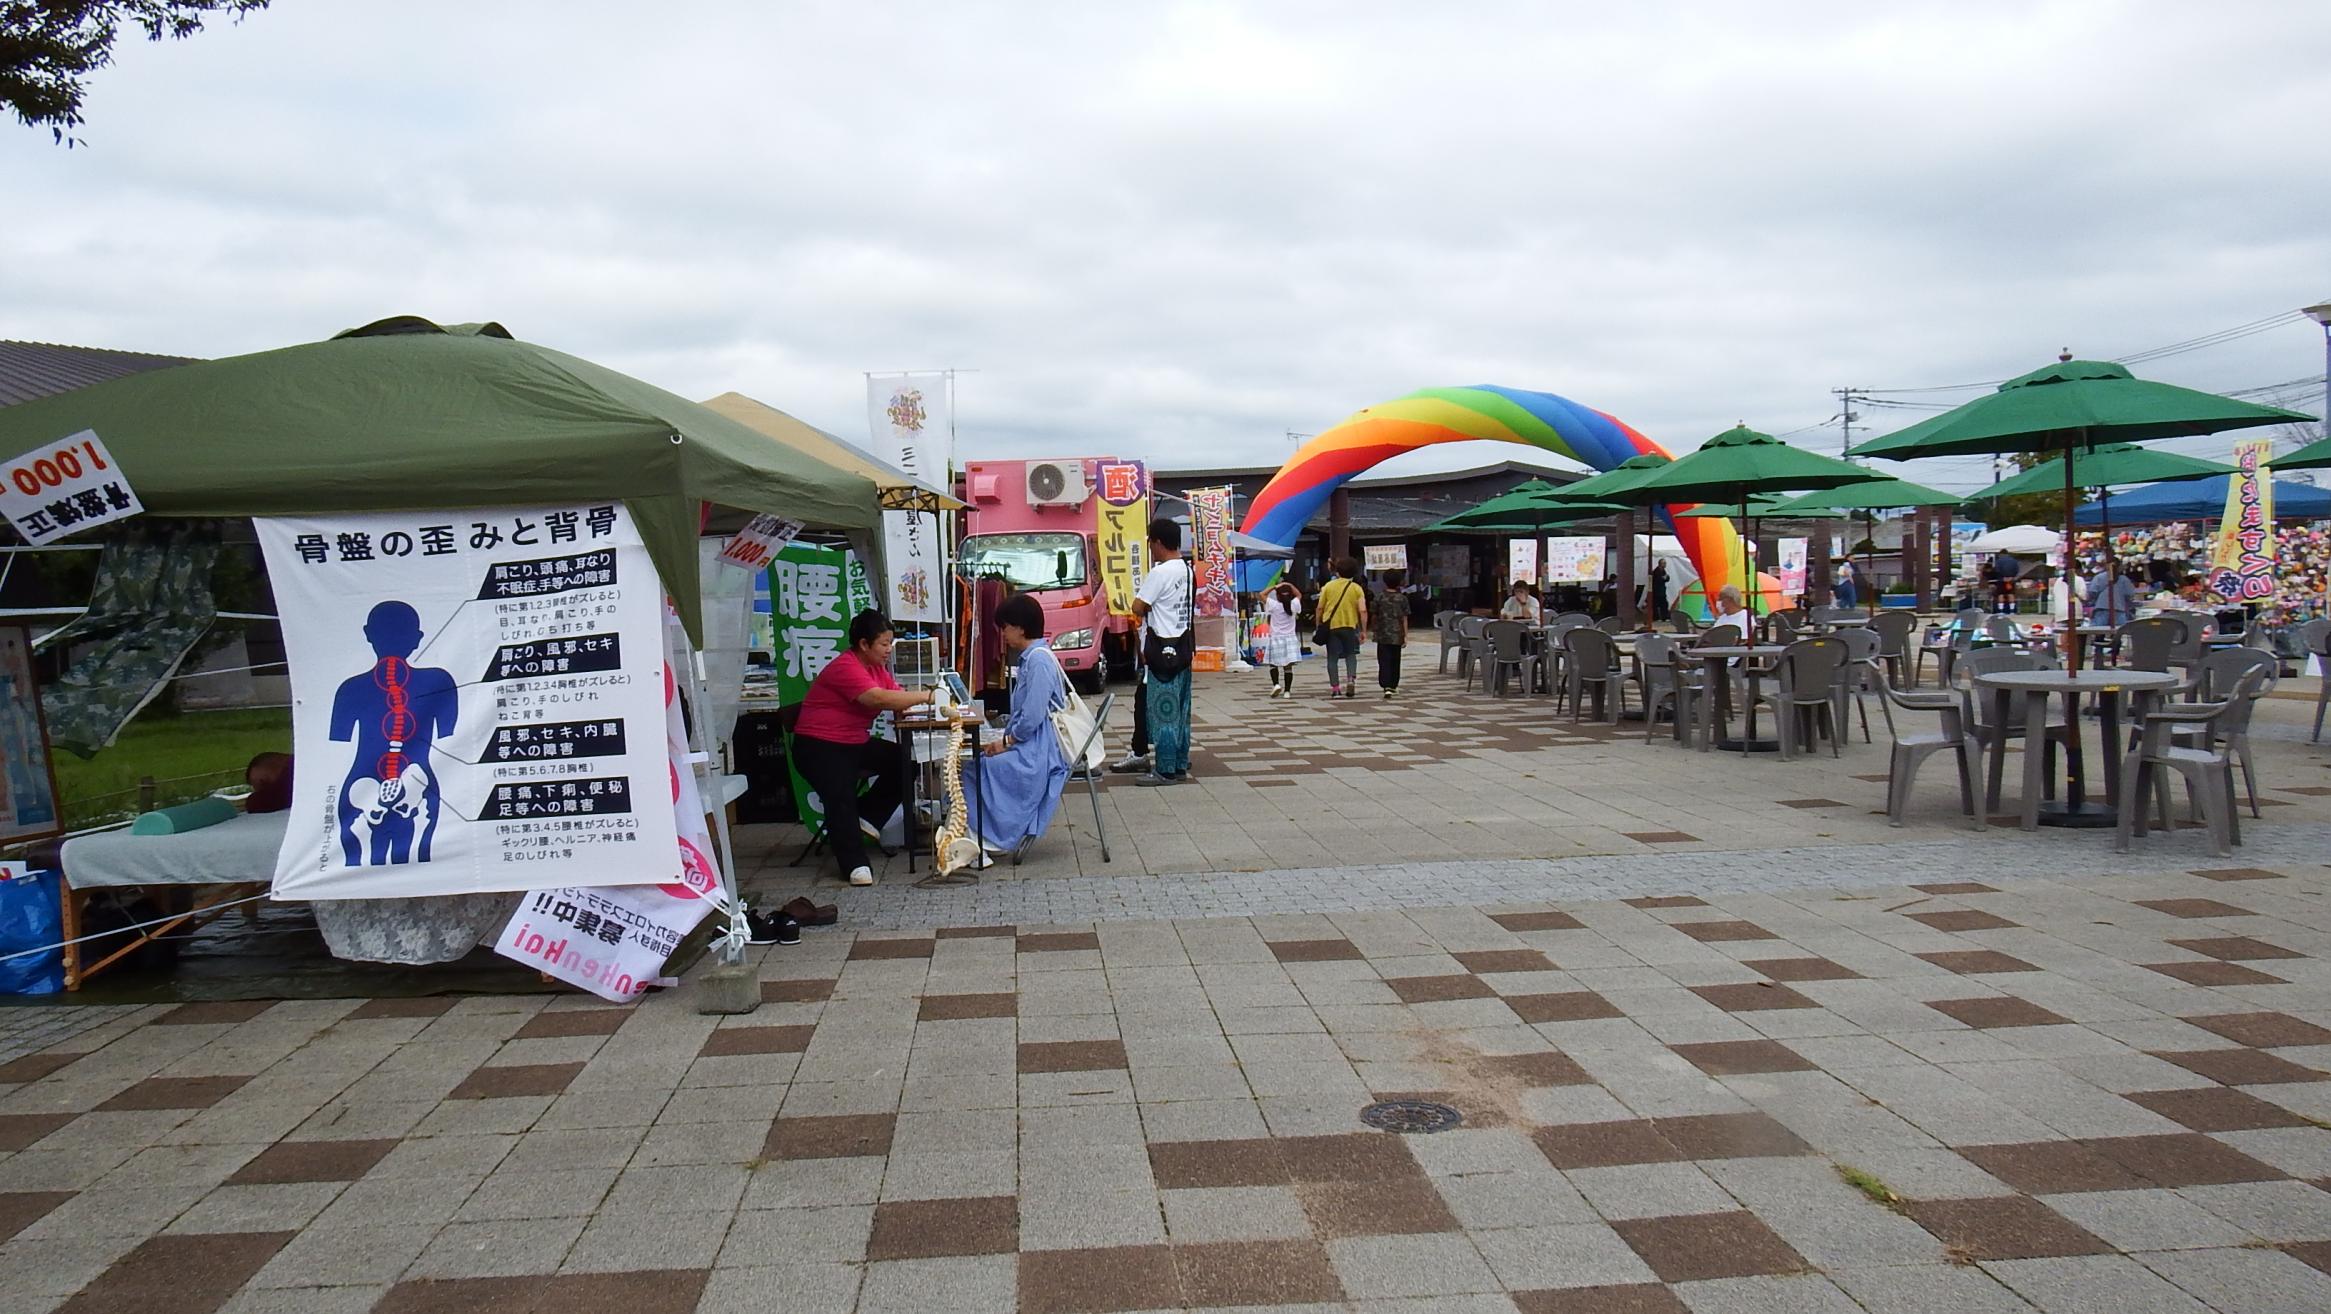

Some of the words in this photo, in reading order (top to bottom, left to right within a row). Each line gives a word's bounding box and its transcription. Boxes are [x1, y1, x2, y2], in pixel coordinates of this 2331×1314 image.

[0, 440, 107, 496] 1,000
[17, 481, 130, 538] 骨盤矯正
[294, 505, 617, 564] 骨盤の歪みと背骨
[495, 553, 611, 579] 肩こり、頭痛、耳なり
[496, 569, 611, 596] 不眠症、手等への障害
[775, 559, 845, 682] 腰痛
[500, 637, 614, 662] 肩こり、風邪、セキ
[498, 722, 618, 743] 風邪、セキ、内臓
[498, 742, 574, 759] 等への障害
[498, 780, 623, 800] 腰痛、下痢、便秘
[498, 799, 594, 817] 足等への障害
[503, 848, 573, 862] 足のしびれ等
